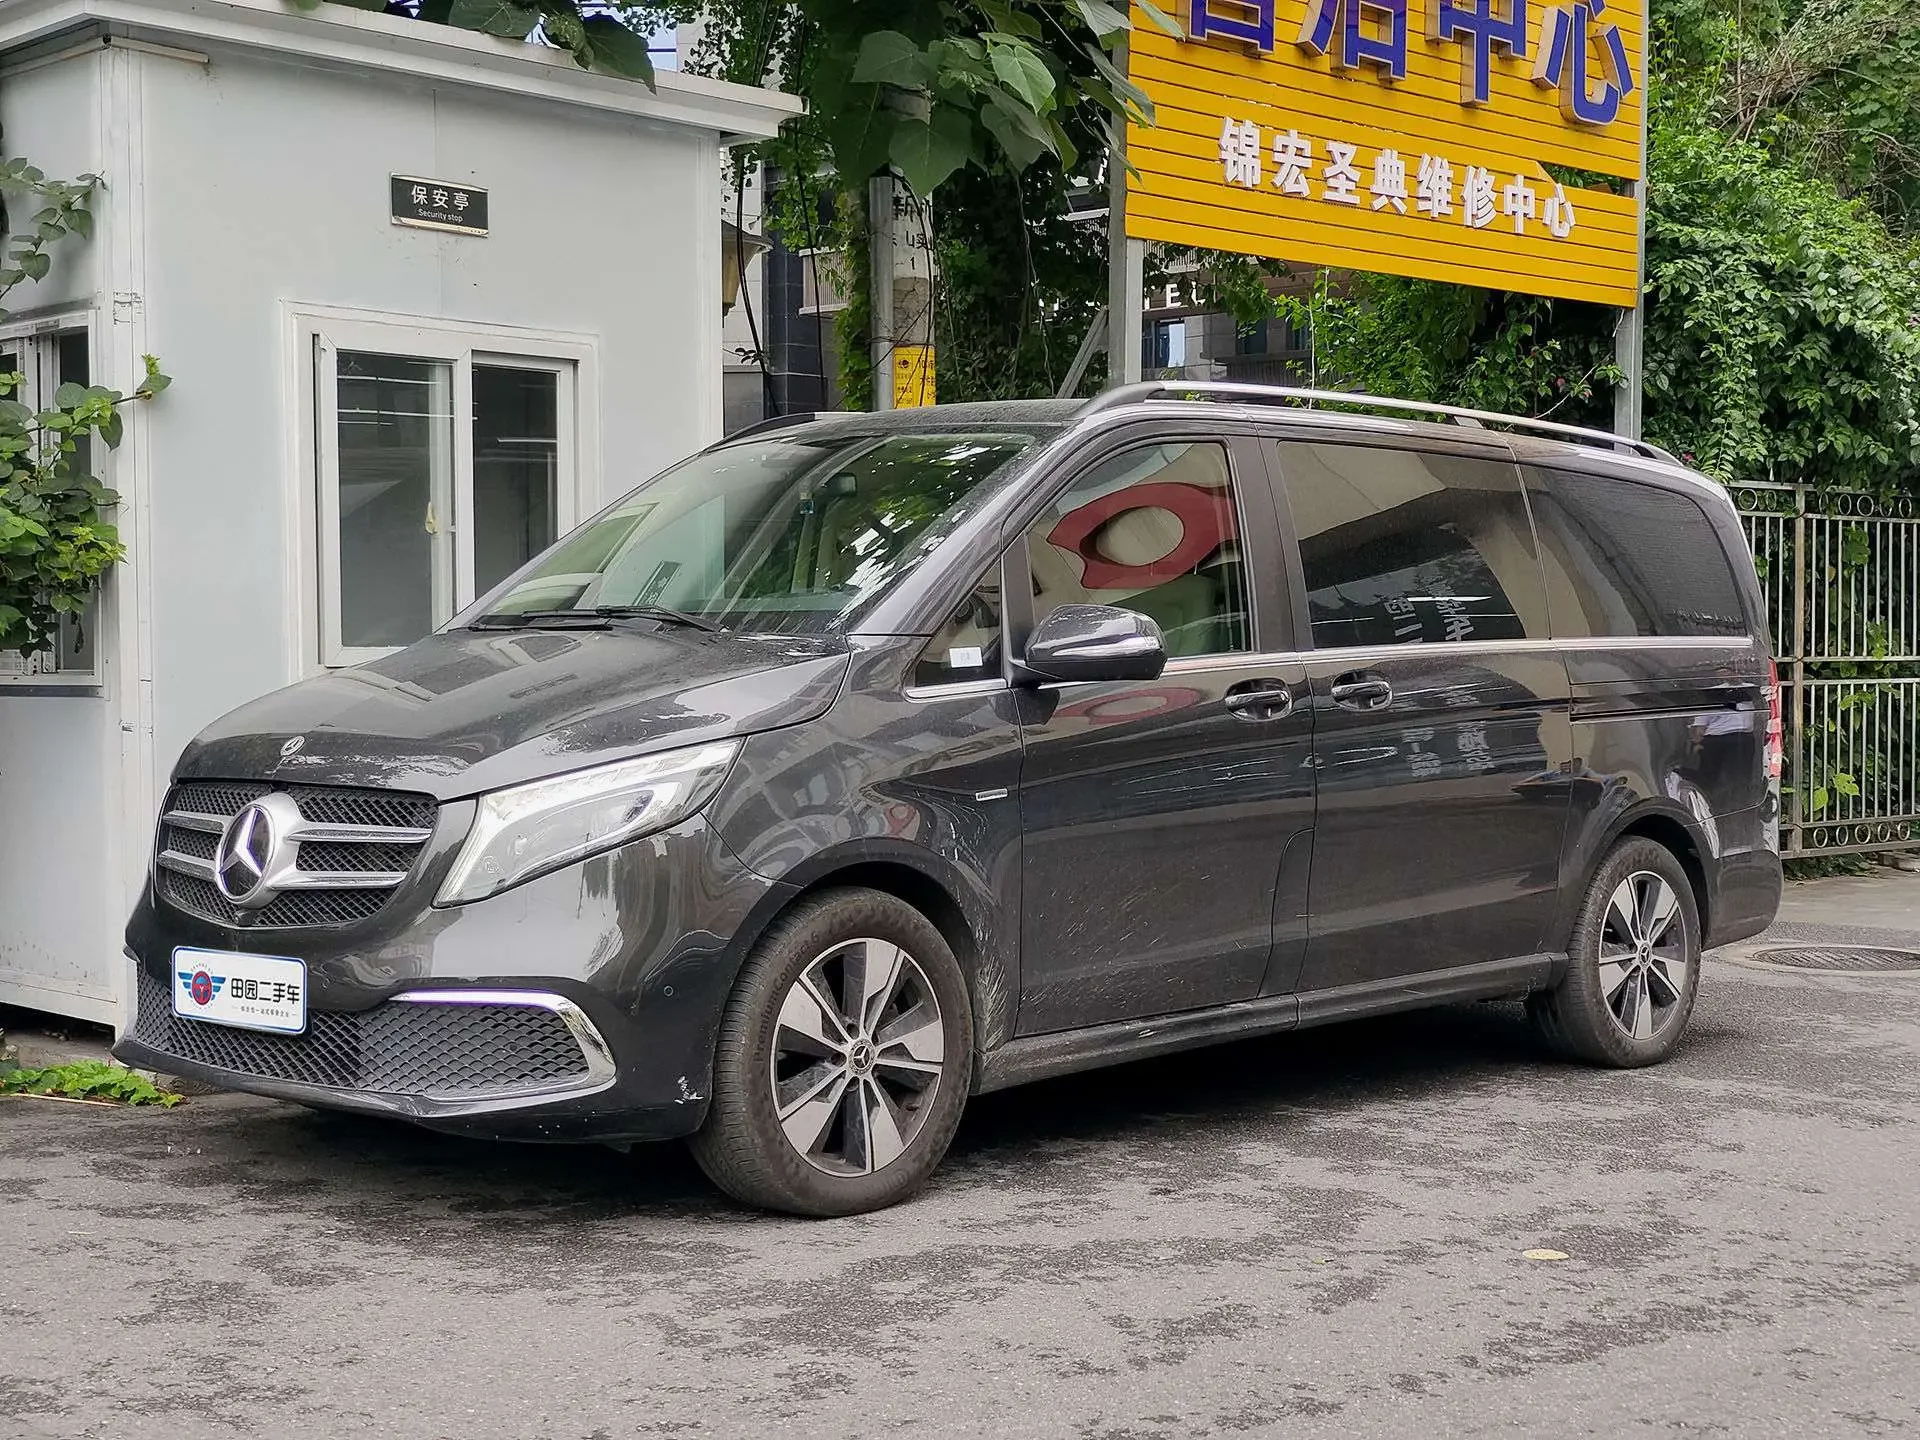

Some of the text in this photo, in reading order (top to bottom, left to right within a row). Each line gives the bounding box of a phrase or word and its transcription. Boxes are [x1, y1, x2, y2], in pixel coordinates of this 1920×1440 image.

[1219, 116, 1576, 238] 锦宏圣典维修中心
[411, 185, 469, 211] 保安亭
[418, 208, 463, 223] Security stop
[231, 978, 300, 1004] 田园二手车
